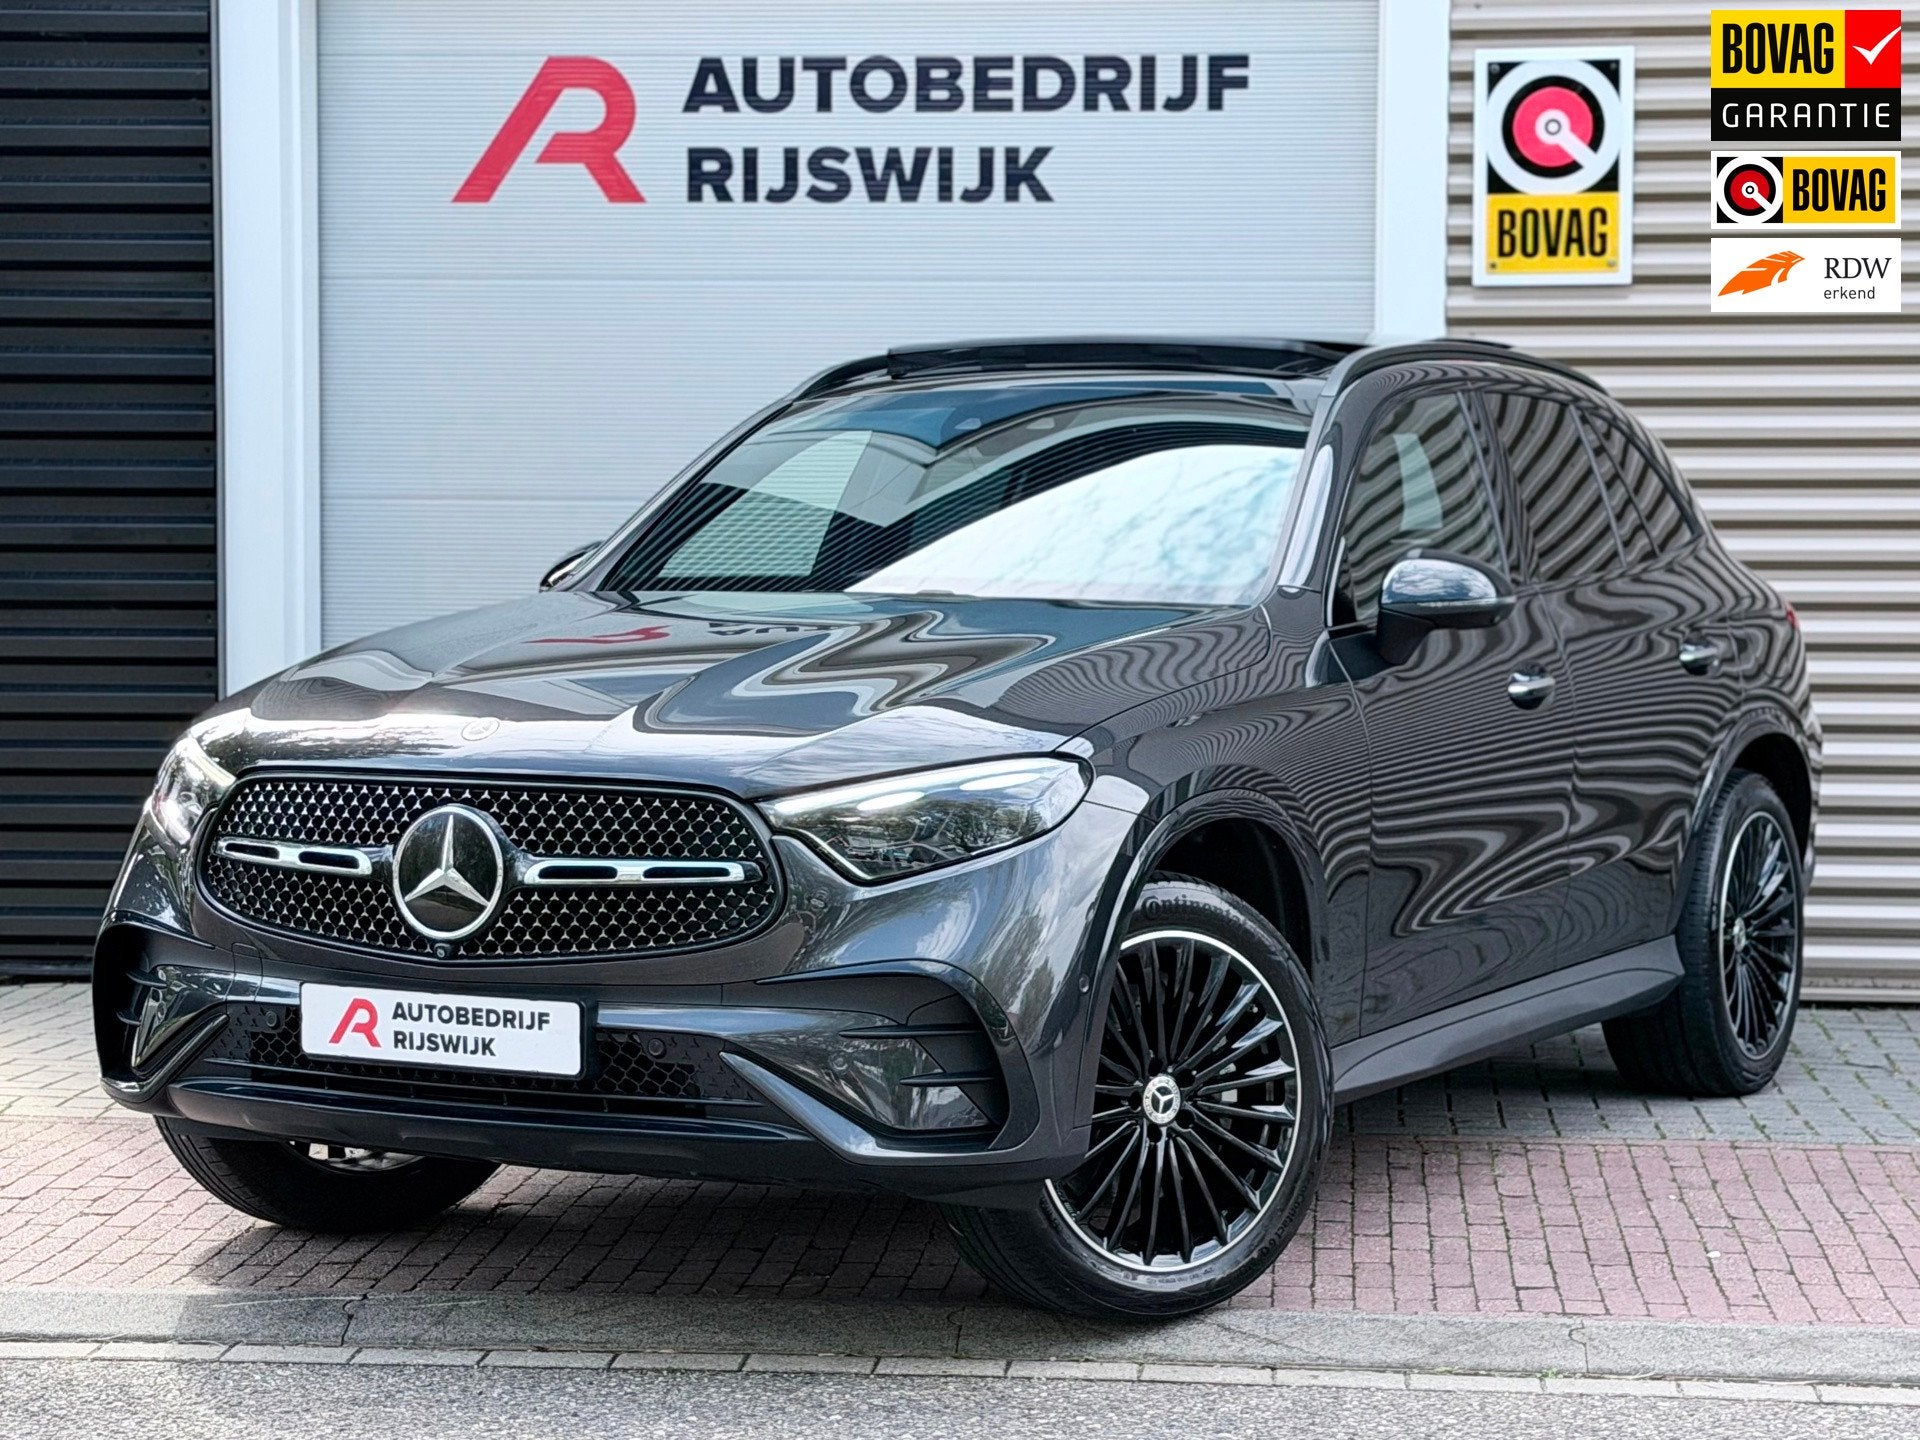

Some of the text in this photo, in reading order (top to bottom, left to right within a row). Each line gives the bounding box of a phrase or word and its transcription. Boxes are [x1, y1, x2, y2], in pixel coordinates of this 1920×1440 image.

[682, 54, 1250, 113] AUTOBEDRIJF
[687, 146, 1054, 204] RIJSWIJK
[1498, 207, 1607, 258] BOVAG
[392, 1001, 551, 1031] AUTOBEDRIJF
[393, 1030, 496, 1057] RIJSWIJK
